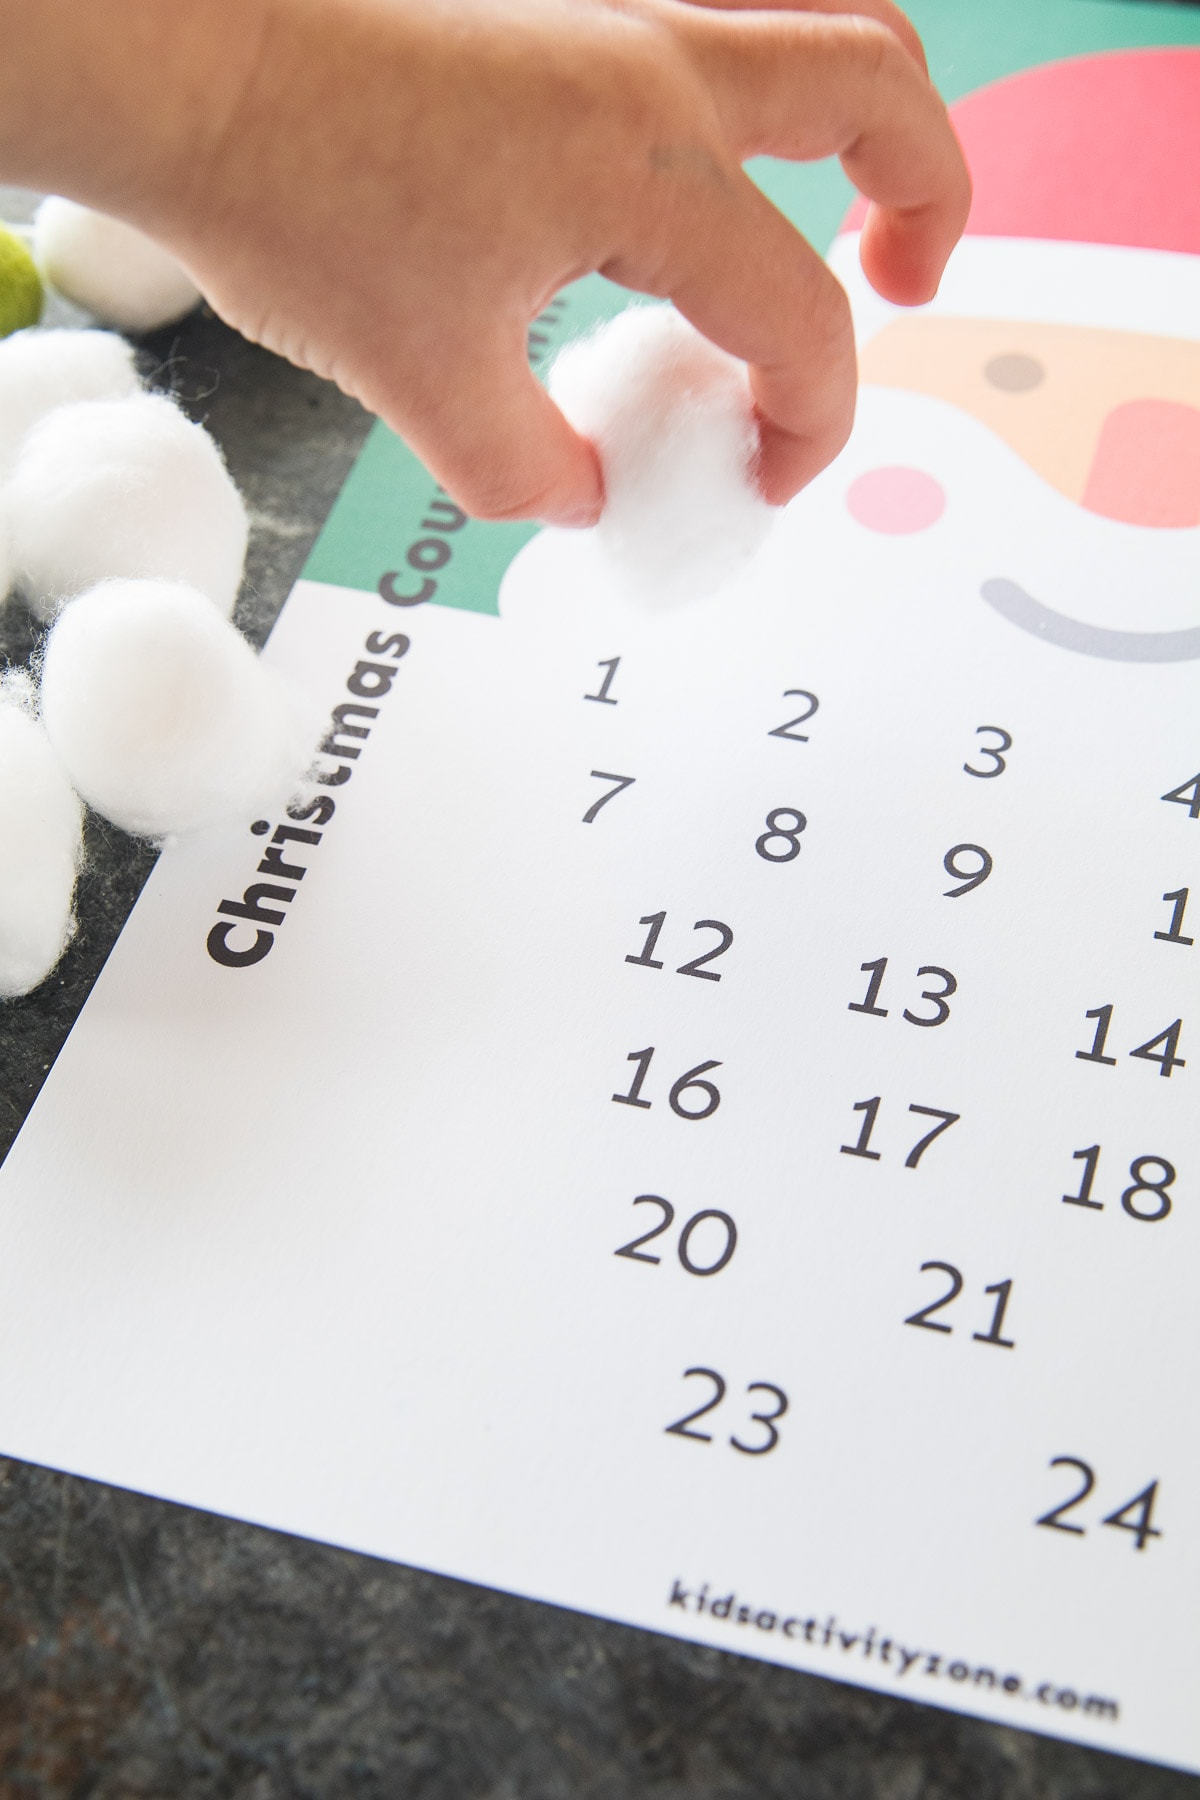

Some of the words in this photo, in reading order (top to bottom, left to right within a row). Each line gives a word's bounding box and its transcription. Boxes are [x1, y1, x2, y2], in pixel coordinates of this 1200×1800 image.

[584, 656, 621, 705] 1
[767, 689, 819, 743] 2
[963, 725, 1013, 779] 3
[1160, 772, 1200, 819] 4
[582, 770, 636, 824] 7
[754, 807, 808, 863] 8
[942, 843, 993, 898] 9
[624, 910, 734, 983] 12
[847, 956, 958, 1028] 13
[1074, 1003, 1186, 1078] 14
[611, 1046, 724, 1121] 16
[839, 1096, 961, 1169] 17
[1061, 1144, 1177, 1223] 18
[613, 1194, 738, 1277] 20
[903, 1260, 1015, 1350] 21
[664, 1367, 789, 1456] 23
[1035, 1455, 1163, 1552] 24
[669, 1579, 1120, 1720] kidsactivityzone.com
